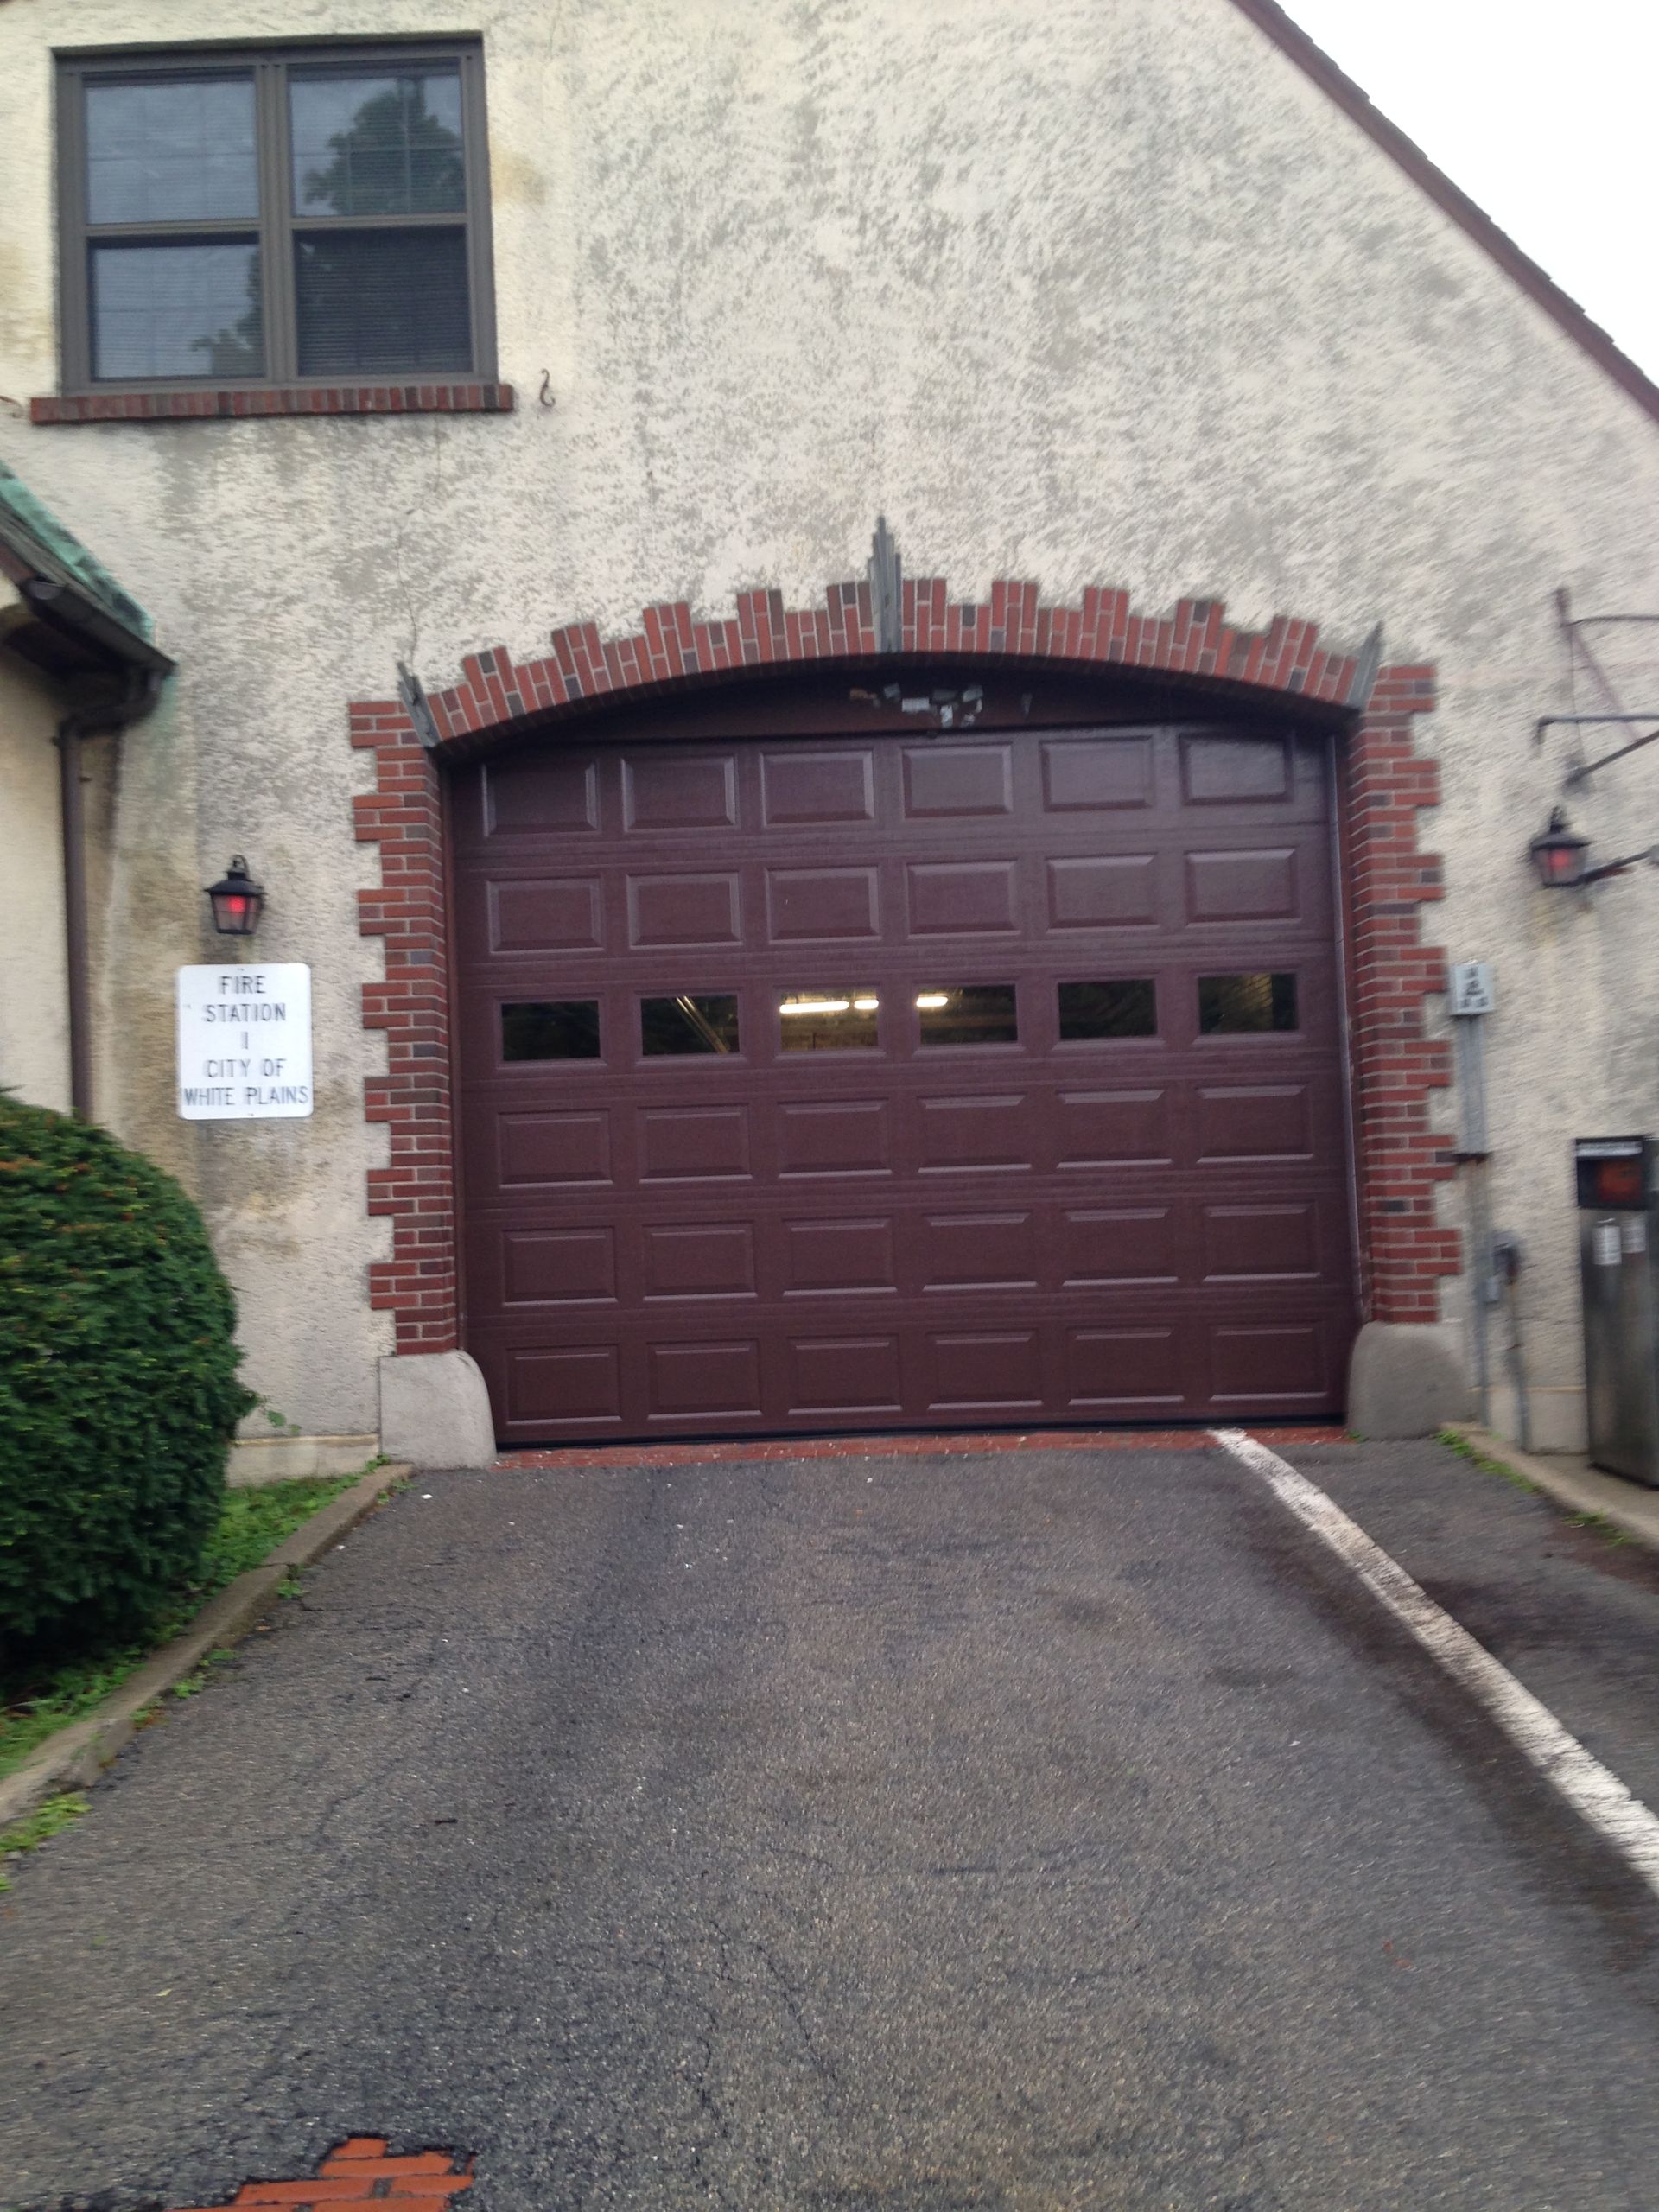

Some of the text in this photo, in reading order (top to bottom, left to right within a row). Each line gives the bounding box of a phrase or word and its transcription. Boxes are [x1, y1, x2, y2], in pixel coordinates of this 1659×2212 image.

[219, 976, 266, 995] FIRE
[204, 1003, 286, 1022] STATION
[205, 1058, 287, 1077] CITY OF
[184, 1085, 308, 1106] WHITE PLAINS
